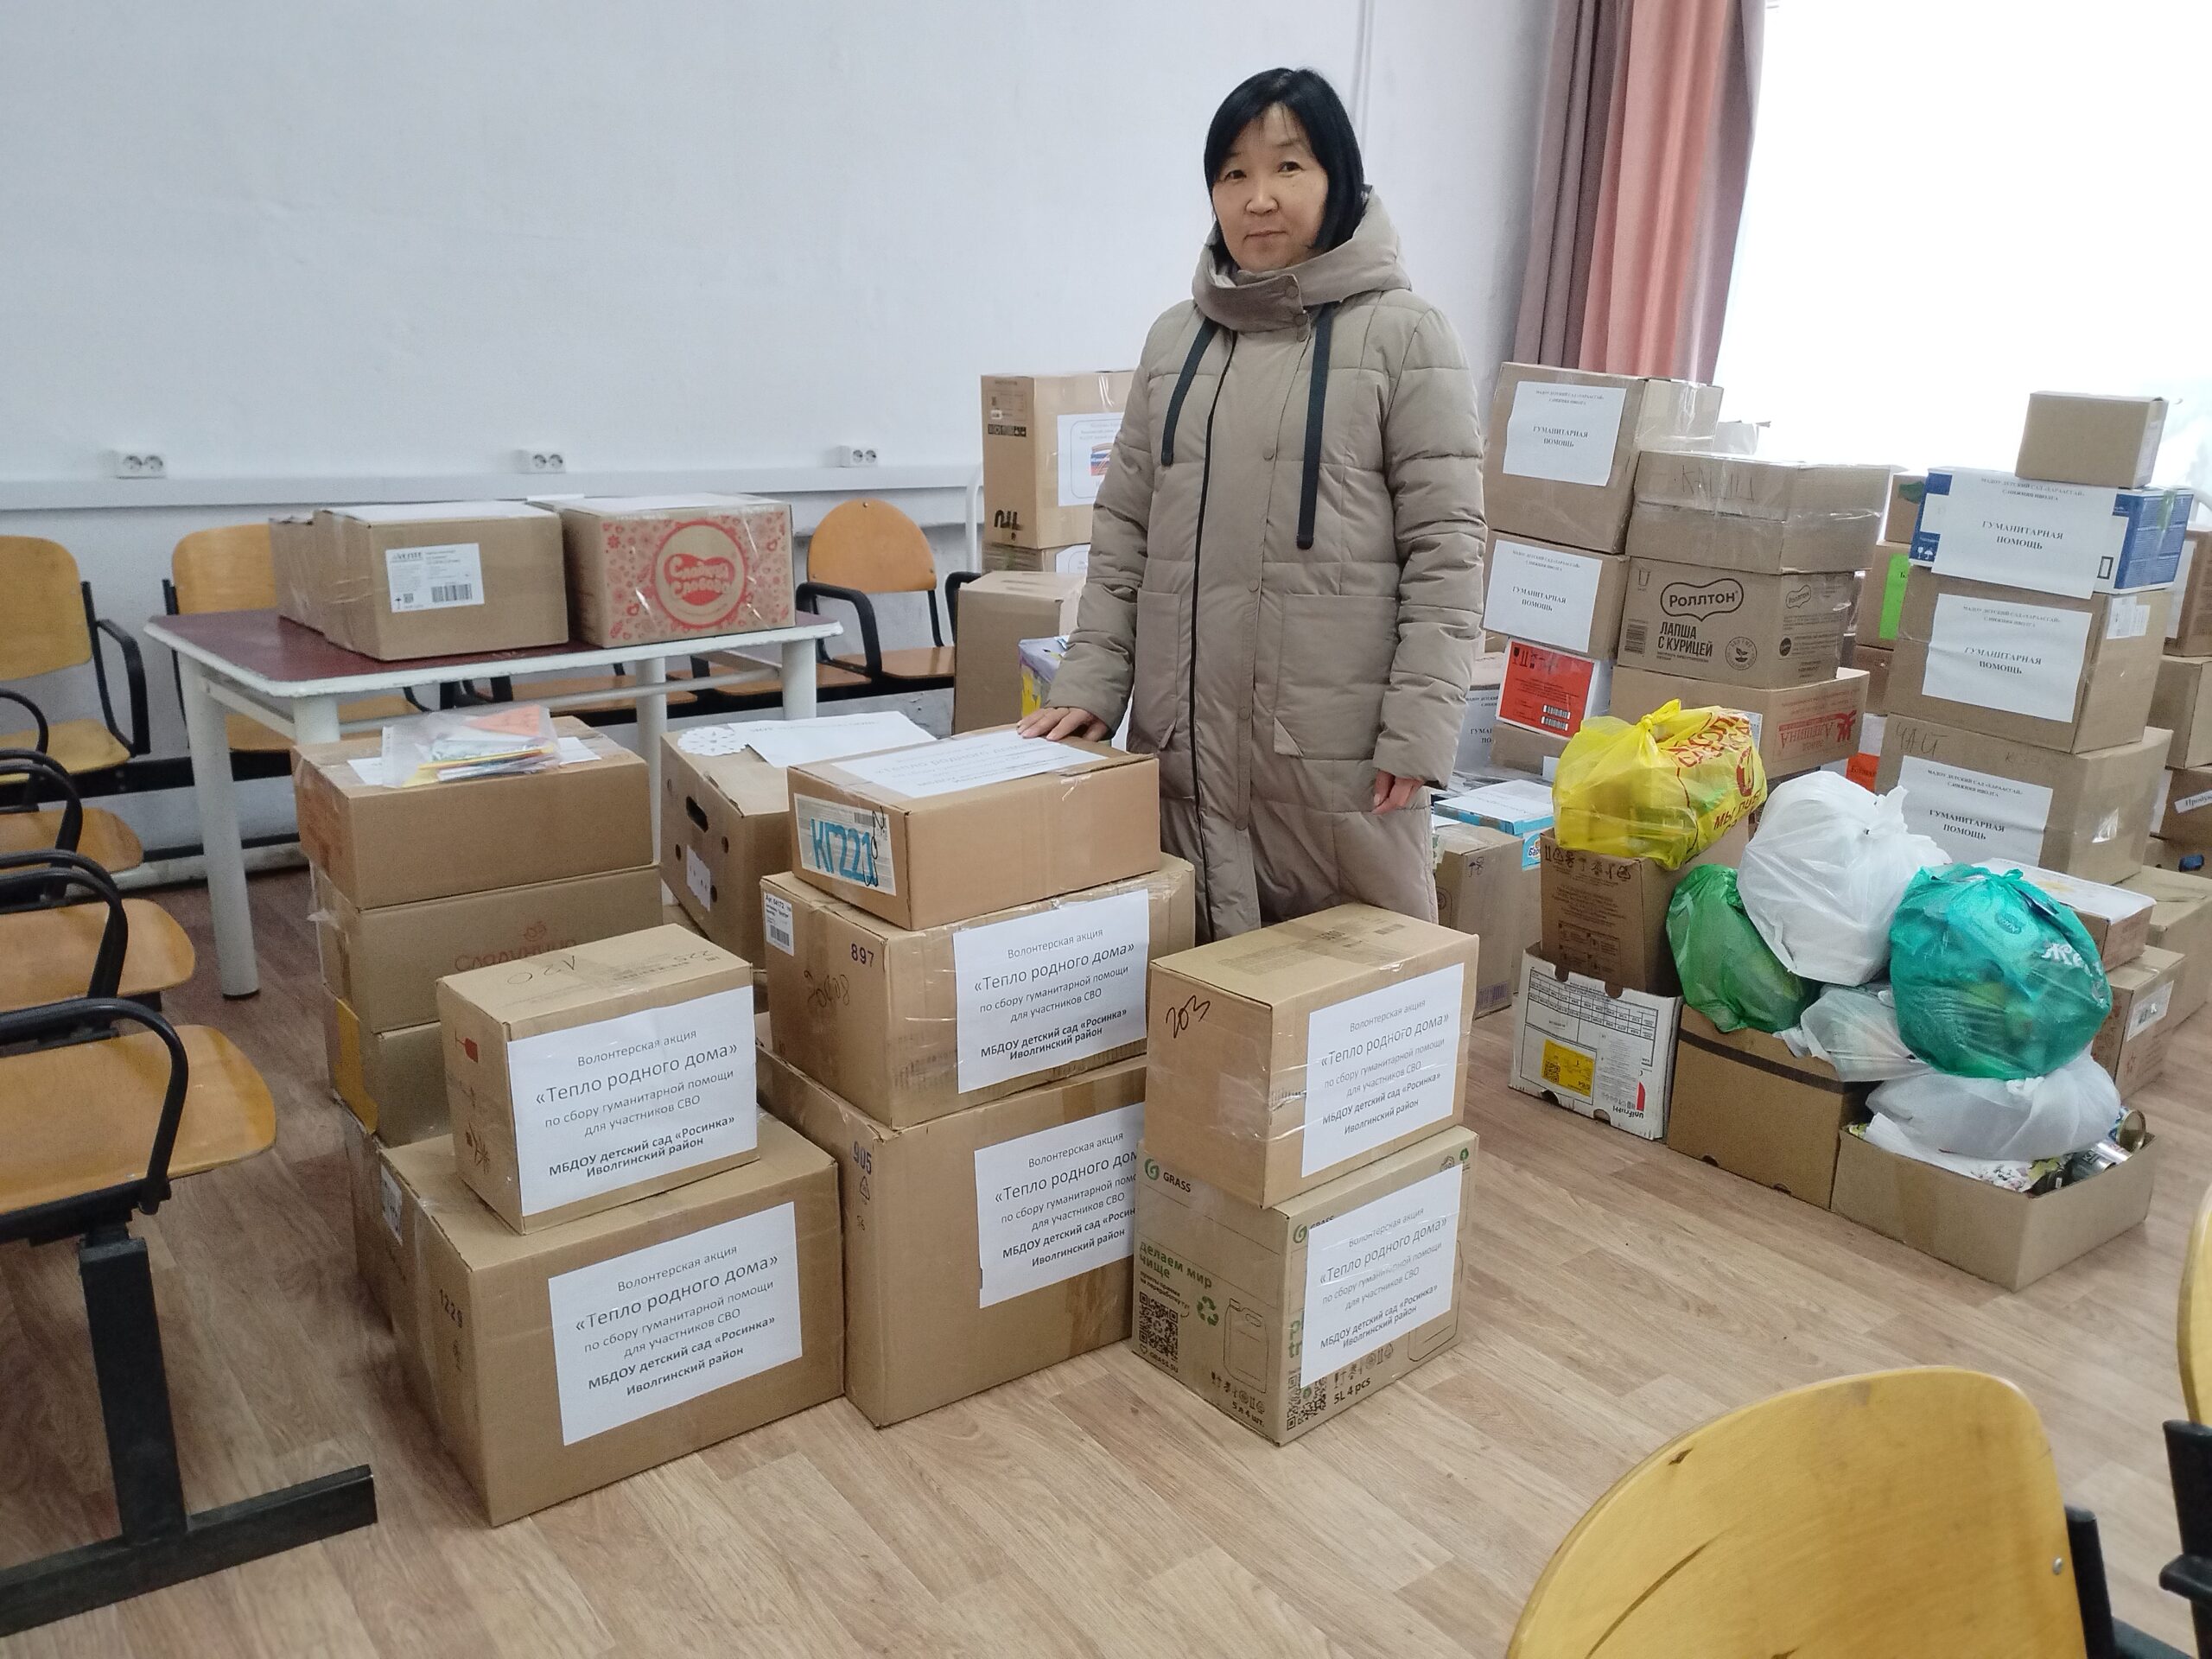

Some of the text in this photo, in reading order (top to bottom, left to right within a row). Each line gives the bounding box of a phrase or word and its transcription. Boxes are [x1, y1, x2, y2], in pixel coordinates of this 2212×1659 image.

[1982, 520, 2063, 539] ГУМАНИТАРНАЯ
[1997, 536, 2043, 550] ПОМОЩЬ
[1657, 636, 1664, 649] С
[1666, 638, 1713, 658] КУРИЦЕЙ
[1659, 621, 1697, 639] ЛАПША
[1929, 810, 2005, 833] ГУМАНИТАРНАЯ
[1943, 823, 1986, 840] ПОМОЩЬ
[851, 943, 874, 968] 897
[1007, 928, 1103, 959] Волонтерская акция
[973, 942, 1135, 992] «Тепло родного дома»
[978, 965, 1128, 1014] по сбору гуманитарной помощи
[1008, 987, 1103, 1024] для участников СВО
[980, 1007, 1128, 1058] МБДОУ детский сад «Росинка»
[1349, 998, 1426, 1033] Волонтерская акция
[576, 1029, 696, 1067] Волонтерская акция
[1008, 1023, 1103, 1061] Иволгинский район
[1365, 1024, 1414, 1057] родного
[535, 1043, 738, 1104] «Тепло родного дома»
[1323, 1037, 1445, 1089] по сбору гуманитарной помощи
[1344, 1059, 1422, 1099] для участников СВО
[544, 1069, 734, 1128] по сбору гуманитарной помощи
[583, 1094, 701, 1138] для участников СВО
[1321, 1103, 1354, 1126] МБДОУ
[1352, 1090, 1386, 1115] детский
[1385, 1087, 1402, 1100] сад
[1343, 1097, 1419, 1135] Иволгинский район
[548, 1116, 735, 1177] МБДОУ детский сад «Росинка»
[585, 1135, 704, 1179] Иволгинский район
[852, 1141, 872, 1175] 905
[1027, 1131, 1124, 1168] Волонтерская акция
[994, 1150, 1137, 1203] «Тепло родного дом
[1163, 1172, 1192, 1193] GRASS
[1000, 1212, 1014, 1224] по
[1014, 1202, 1045, 1219] сбору
[1045, 1178, 1113, 1211] гуманитарной
[1030, 1191, 1125, 1234] для участников СВО
[1001, 1236, 1041, 1259] МБДОУ
[1041, 1222, 1083, 1248] детский
[1083, 1218, 1102, 1231] сад
[1031, 1227, 1125, 1268] Иволгинский район
[616, 1245, 737, 1293] Волонтерская акция
[1140, 1242, 1213, 1290] делаем мир
[1140, 1253, 1171, 1280] чище
[575, 1255, 779, 1332] «Тепло родного дома»
[583, 1280, 774, 1353] по сбору гуманитарной помощи
[622, 1307, 741, 1360] для участников СВО
[588, 1315, 775, 1390] МБДОУ детский сад «Росинка»
[626, 1346, 744, 1396] Иволгинский район
[1347, 1388, 1354, 1397] 4
[1355, 1377, 1371, 1396] pcs
